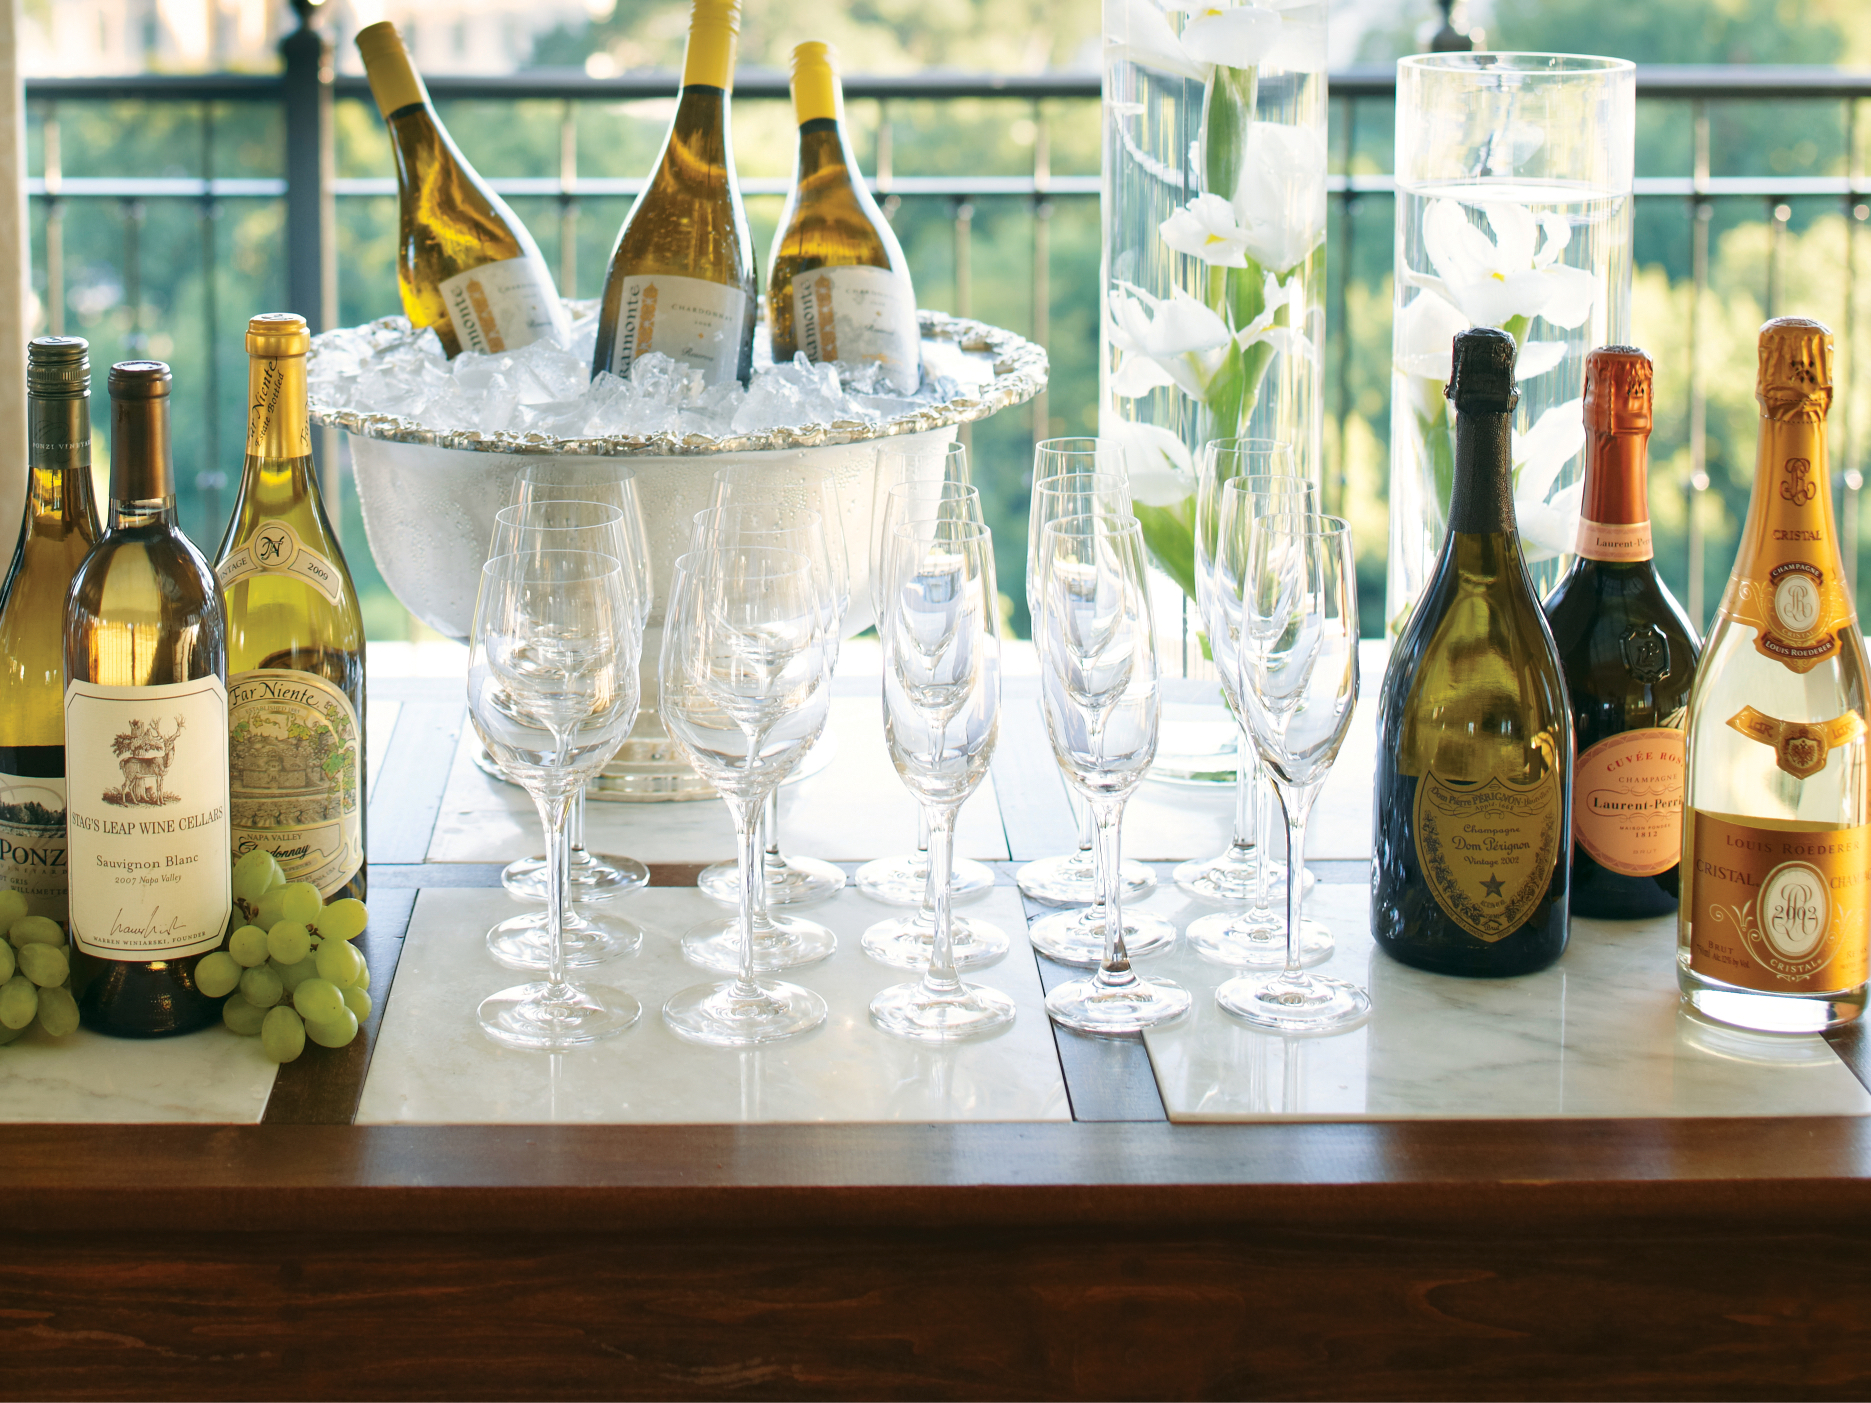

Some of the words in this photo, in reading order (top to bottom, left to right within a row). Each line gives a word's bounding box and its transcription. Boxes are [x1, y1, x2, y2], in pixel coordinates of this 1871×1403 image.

[252, 356, 278, 419] Niente
[255, 417, 271, 447] Estate
[267, 369, 284, 414] Bottled
[1773, 529, 1822, 541] CRISTAL
[220, 557, 248, 581] INTAGE
[307, 562, 329, 581] 2009
[1772, 563, 1820, 576] CHAMPAGNE
[1782, 628, 1813, 638] CRISTAL
[1765, 641, 1789, 655] LOUIS
[1791, 642, 1832, 656] ROEDERER
[230, 685, 257, 706] Far
[1607, 751, 1653, 771] CUVÉE
[1660, 752, 1683, 767] ROS
[1618, 773, 1677, 783] CHAMPAGNE
[1594, 795, 1682, 810] Laurent-Perri
[72, 812, 100, 832] STAG'S
[103, 820, 136, 835] LEAP
[139, 819, 175, 835] WINE
[178, 805, 223, 831] CELLARS
[247, 833, 269, 841] NAPA
[271, 833, 302, 841] VALLEY
[1464, 824, 1521, 836] Champagne
[0, 838, 67, 866] PONZ
[1452, 836, 1482, 851] Dom
[1483, 837, 1530, 855] Pérignon
[1726, 835, 1772, 853] LOUIS
[1782, 840, 1859, 855] ROEDERER
[96, 855, 160, 873] Sauvignon
[165, 854, 199, 867] Blanc
[1464, 856, 1500, 868] Vintage
[1501, 856, 1520, 865] 2002
[115, 876, 137, 885] 2007
[139, 875, 159, 886] Napa
[161, 873, 182, 883] Valley
[1696, 859, 1755, 886] CRISTAL
[10, 877, 28, 885] GRIS
[1774, 905, 1817, 920] 2002
[93, 936, 120, 945] WARREN
[123, 938, 170, 946] WINIARSKI,
[172, 931, 206, 943] FOUNDER
[1708, 940, 1734, 954] BRUT
[1770, 957, 1818, 973] CRISTAL
